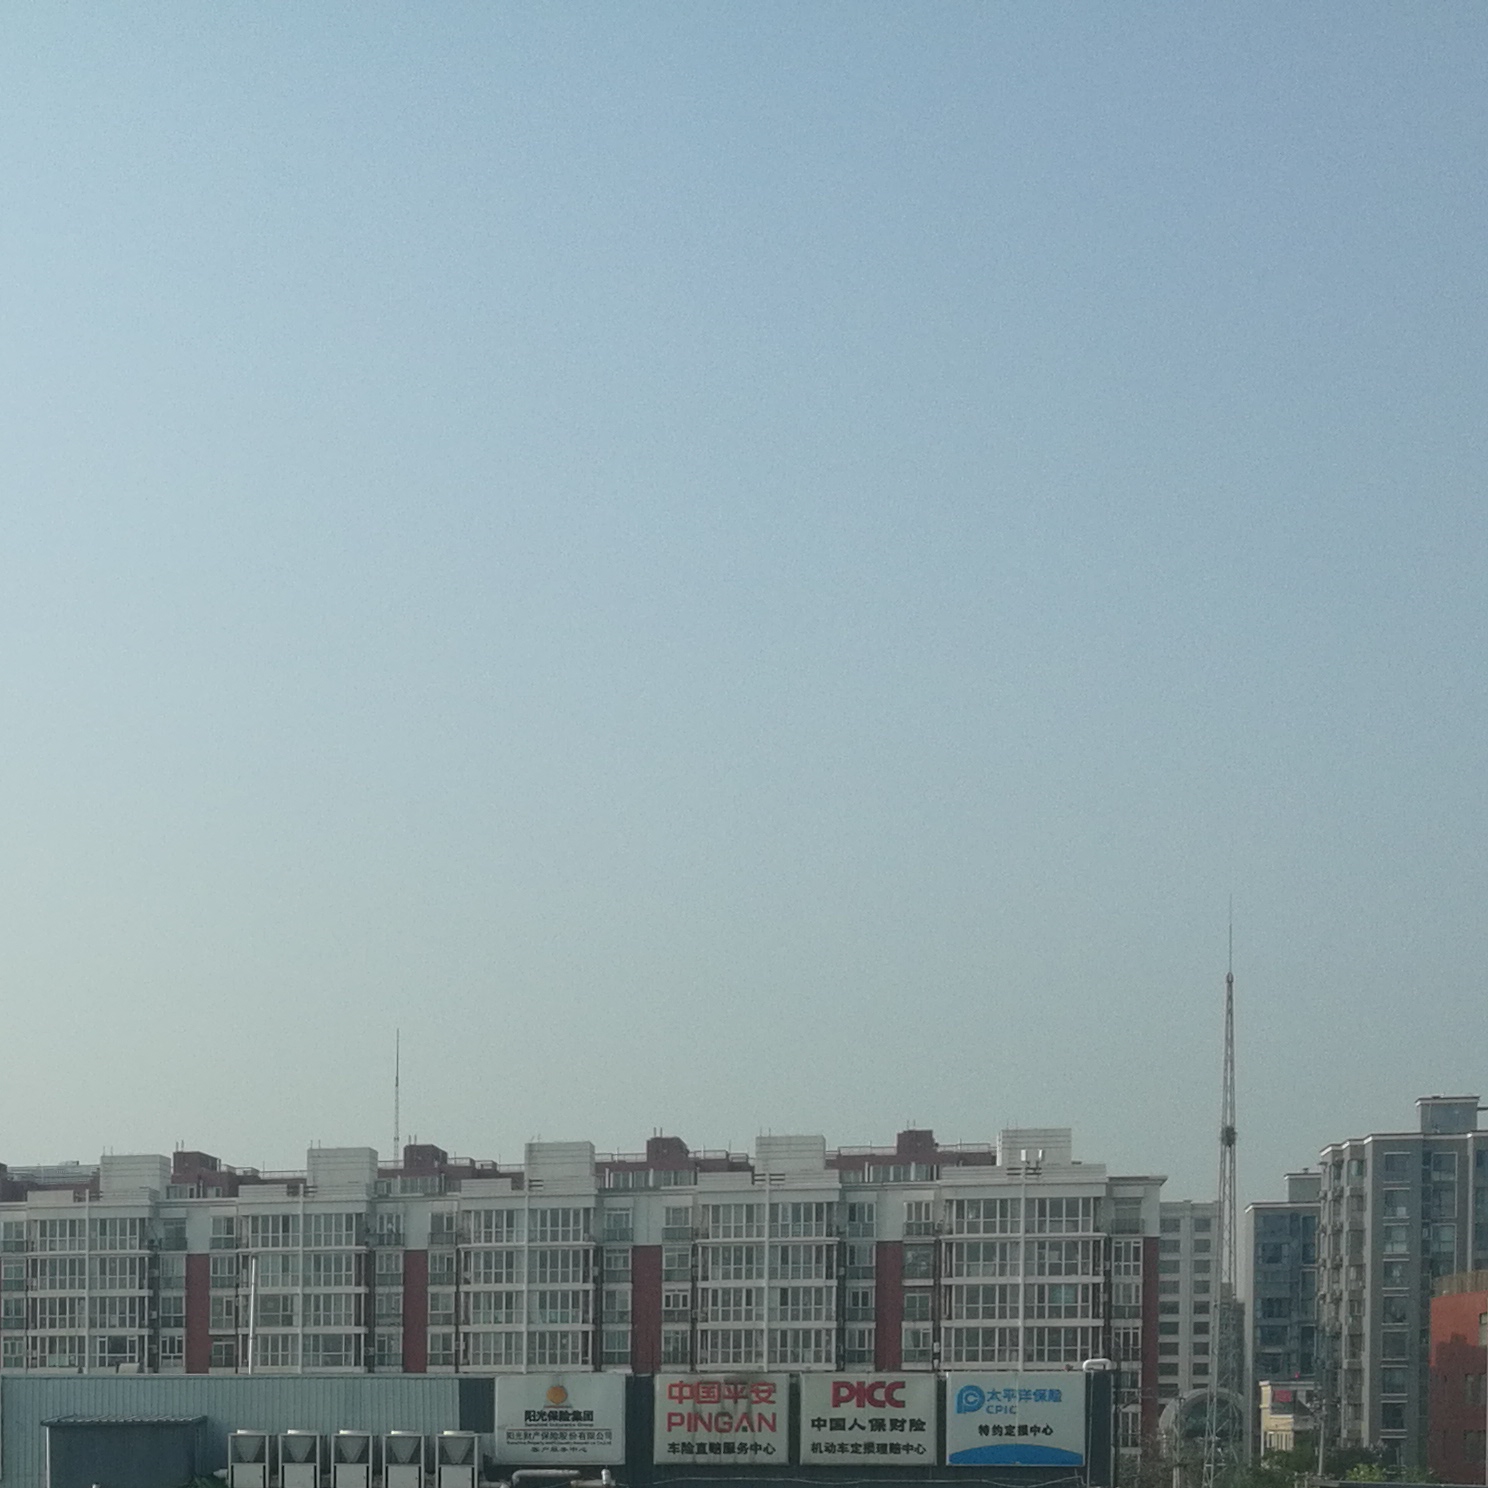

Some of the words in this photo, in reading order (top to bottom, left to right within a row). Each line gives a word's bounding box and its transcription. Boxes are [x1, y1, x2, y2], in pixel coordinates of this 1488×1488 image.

[666, 1381, 777, 1405] 中国平安
[831, 1381, 906, 1409] PICC
[986, 1387, 1063, 1403] 太平洋保险
[524, 1409, 595, 1423] 阳光保险集团
[985, 1404, 1018, 1415] CPIC
[666, 1411, 778, 1434] PINGAN
[810, 1416, 927, 1433] 中国人保财险
[977, 1423, 1054, 1438] 特约定损中心
[667, 1441, 777, 1456] 车险直赔服务中心
[811, 1441, 928, 1456] 机动车定损理赔中心
